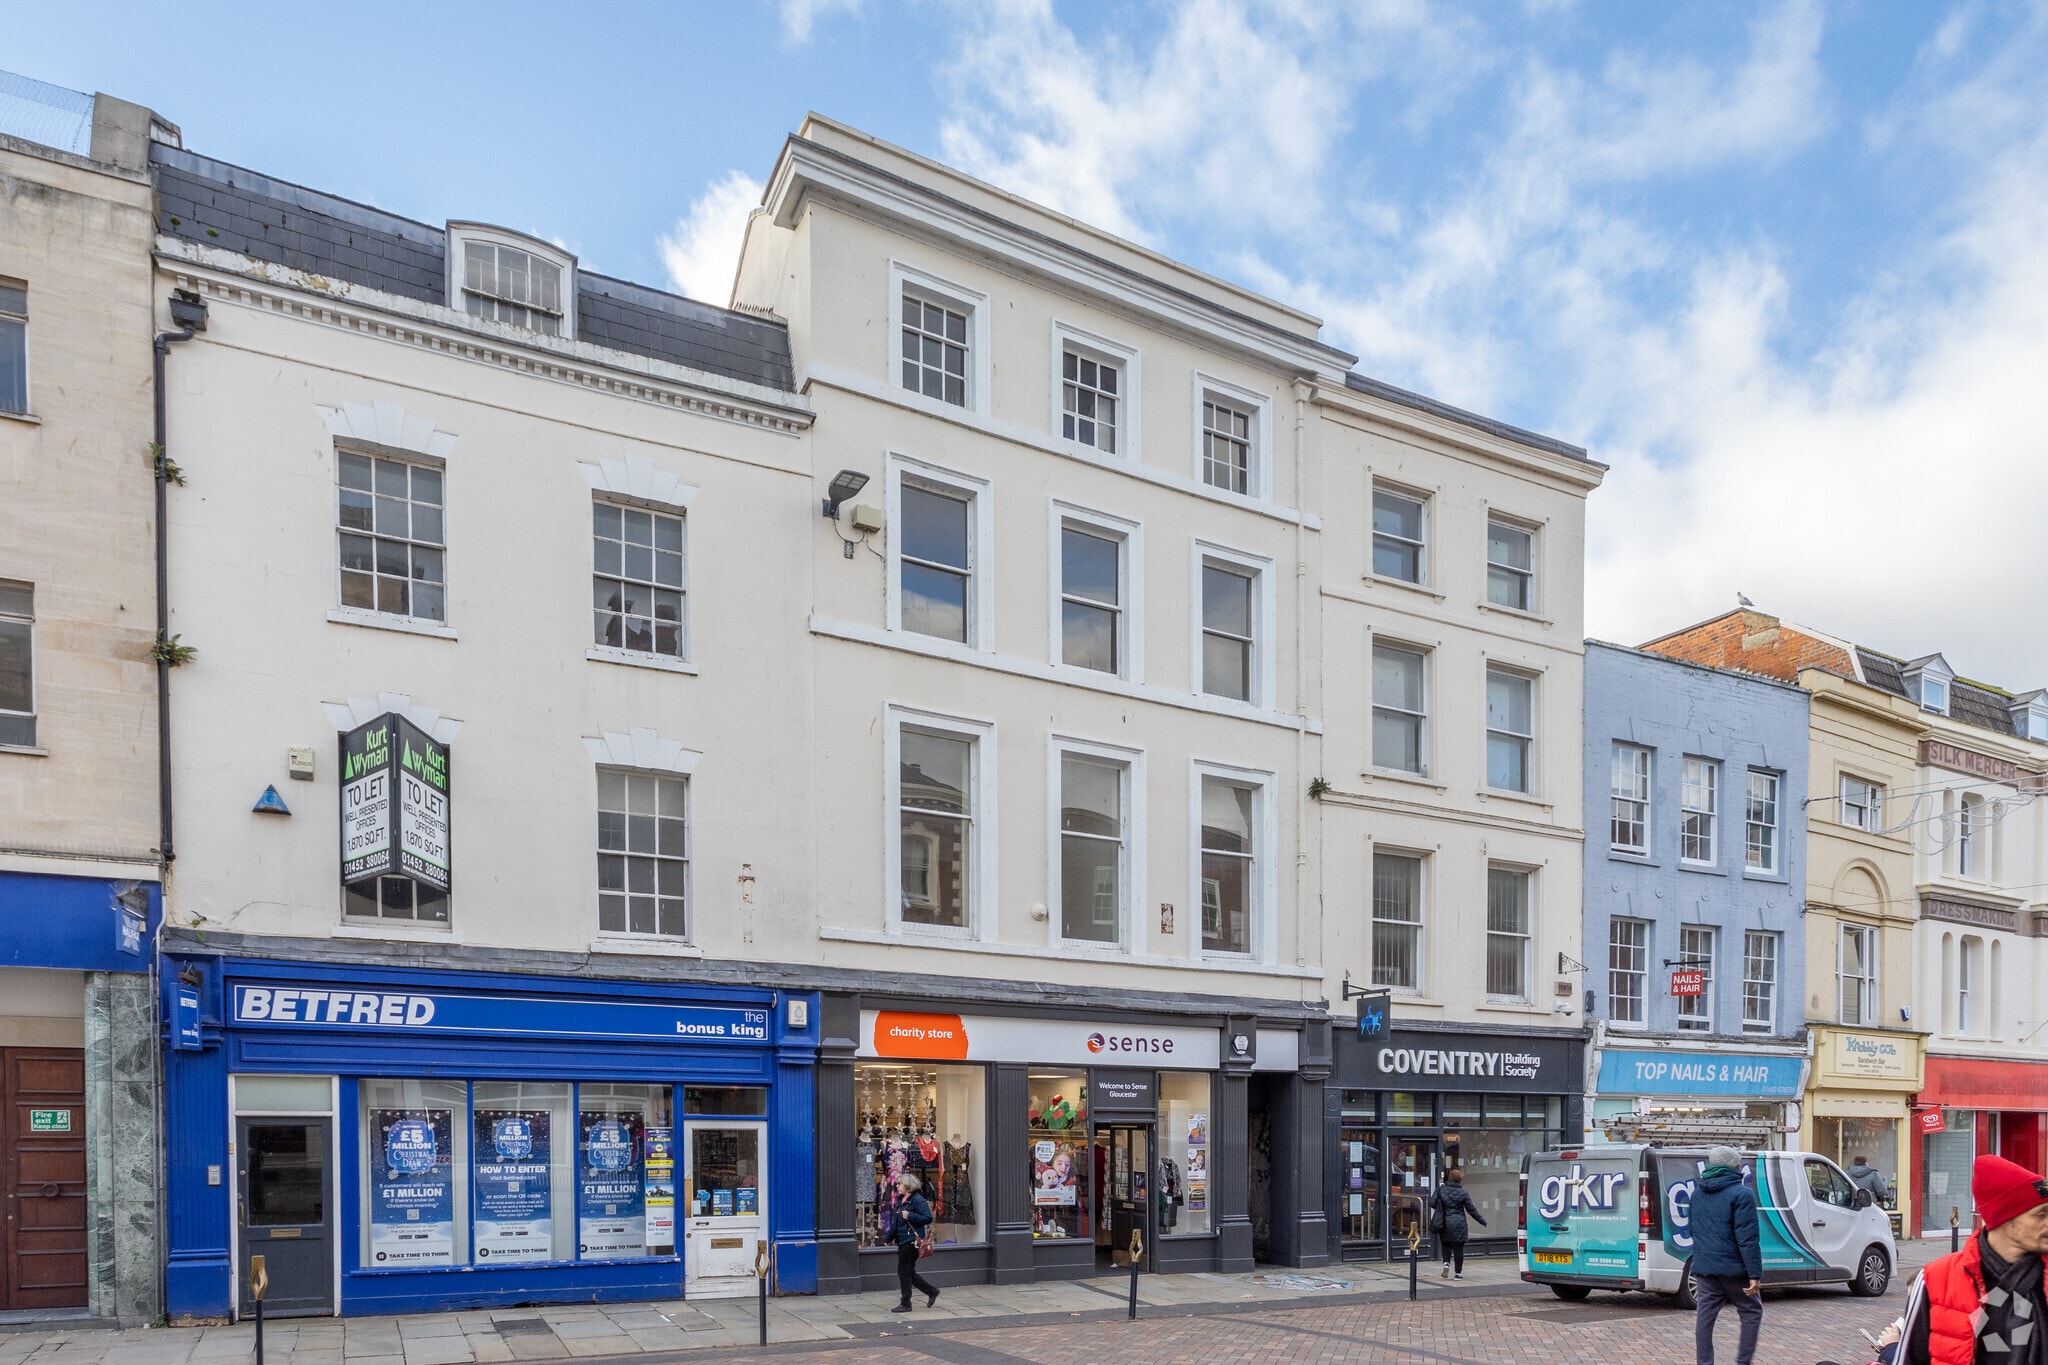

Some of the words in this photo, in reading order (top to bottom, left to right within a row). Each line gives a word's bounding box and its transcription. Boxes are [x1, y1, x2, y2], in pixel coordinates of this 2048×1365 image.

[366, 725, 388, 751] Kurt
[353, 747, 388, 776] Wyman
[426, 743, 446, 773] Kurt
[1930, 744, 1961, 767] SILK
[1965, 752, 2015, 779] MERCER
[412, 751, 446, 790] Wyman
[348, 785, 361, 808] TO
[365, 776, 384, 801] LET
[406, 779, 421, 805] TO
[425, 790, 442, 817] LET
[345, 812, 358, 823] WELL
[359, 799, 388, 815] PRESENTED
[403, 801, 418, 817] WELL
[418, 809, 446, 833] PRESENTED
[356, 815, 377, 831] OFFICES
[415, 820, 435, 839] OFFICES
[344, 858, 364, 874] 01452
[366, 850, 390, 868] 380064
[401, 852, 423, 871] 01452
[425, 862, 448, 883] 380064
[1930, 901, 2015, 927] DRESSMAKING
[1673, 974, 1701, 985] NAILS
[240, 988, 435, 1025] BETFRED
[745, 1011, 764, 1023] the
[676, 1021, 725, 1035] bonus
[731, 1023, 764, 1038] king
[890, 1026, 925, 1040] charity
[927, 1029, 953, 1039] store
[1109, 1036, 1174, 1054] sense
[1377, 1048, 1499, 1076] COVENTRY
[1505, 1053, 1541, 1068] Building
[1505, 1065, 1537, 1079] Society
[1635, 1062, 1668, 1080] TOP
[1671, 1063, 1716, 1082] NAILS
[1719, 1065, 1730, 1082] &
[1733, 1065, 1769, 1083] HAIR
[401, 1129, 424, 1144] £5
[504, 1125, 522, 1136] £5
[600, 1130, 620, 1143] £5
[383, 1189, 395, 1198] £1
[397, 1188, 443, 1198] MILLION
[584, 1185, 595, 1194] £1
[597, 1185, 637, 1194] MILLION
[1539, 1164, 1625, 1220] gkr
[1555, 1254, 1568, 1263] YTS
